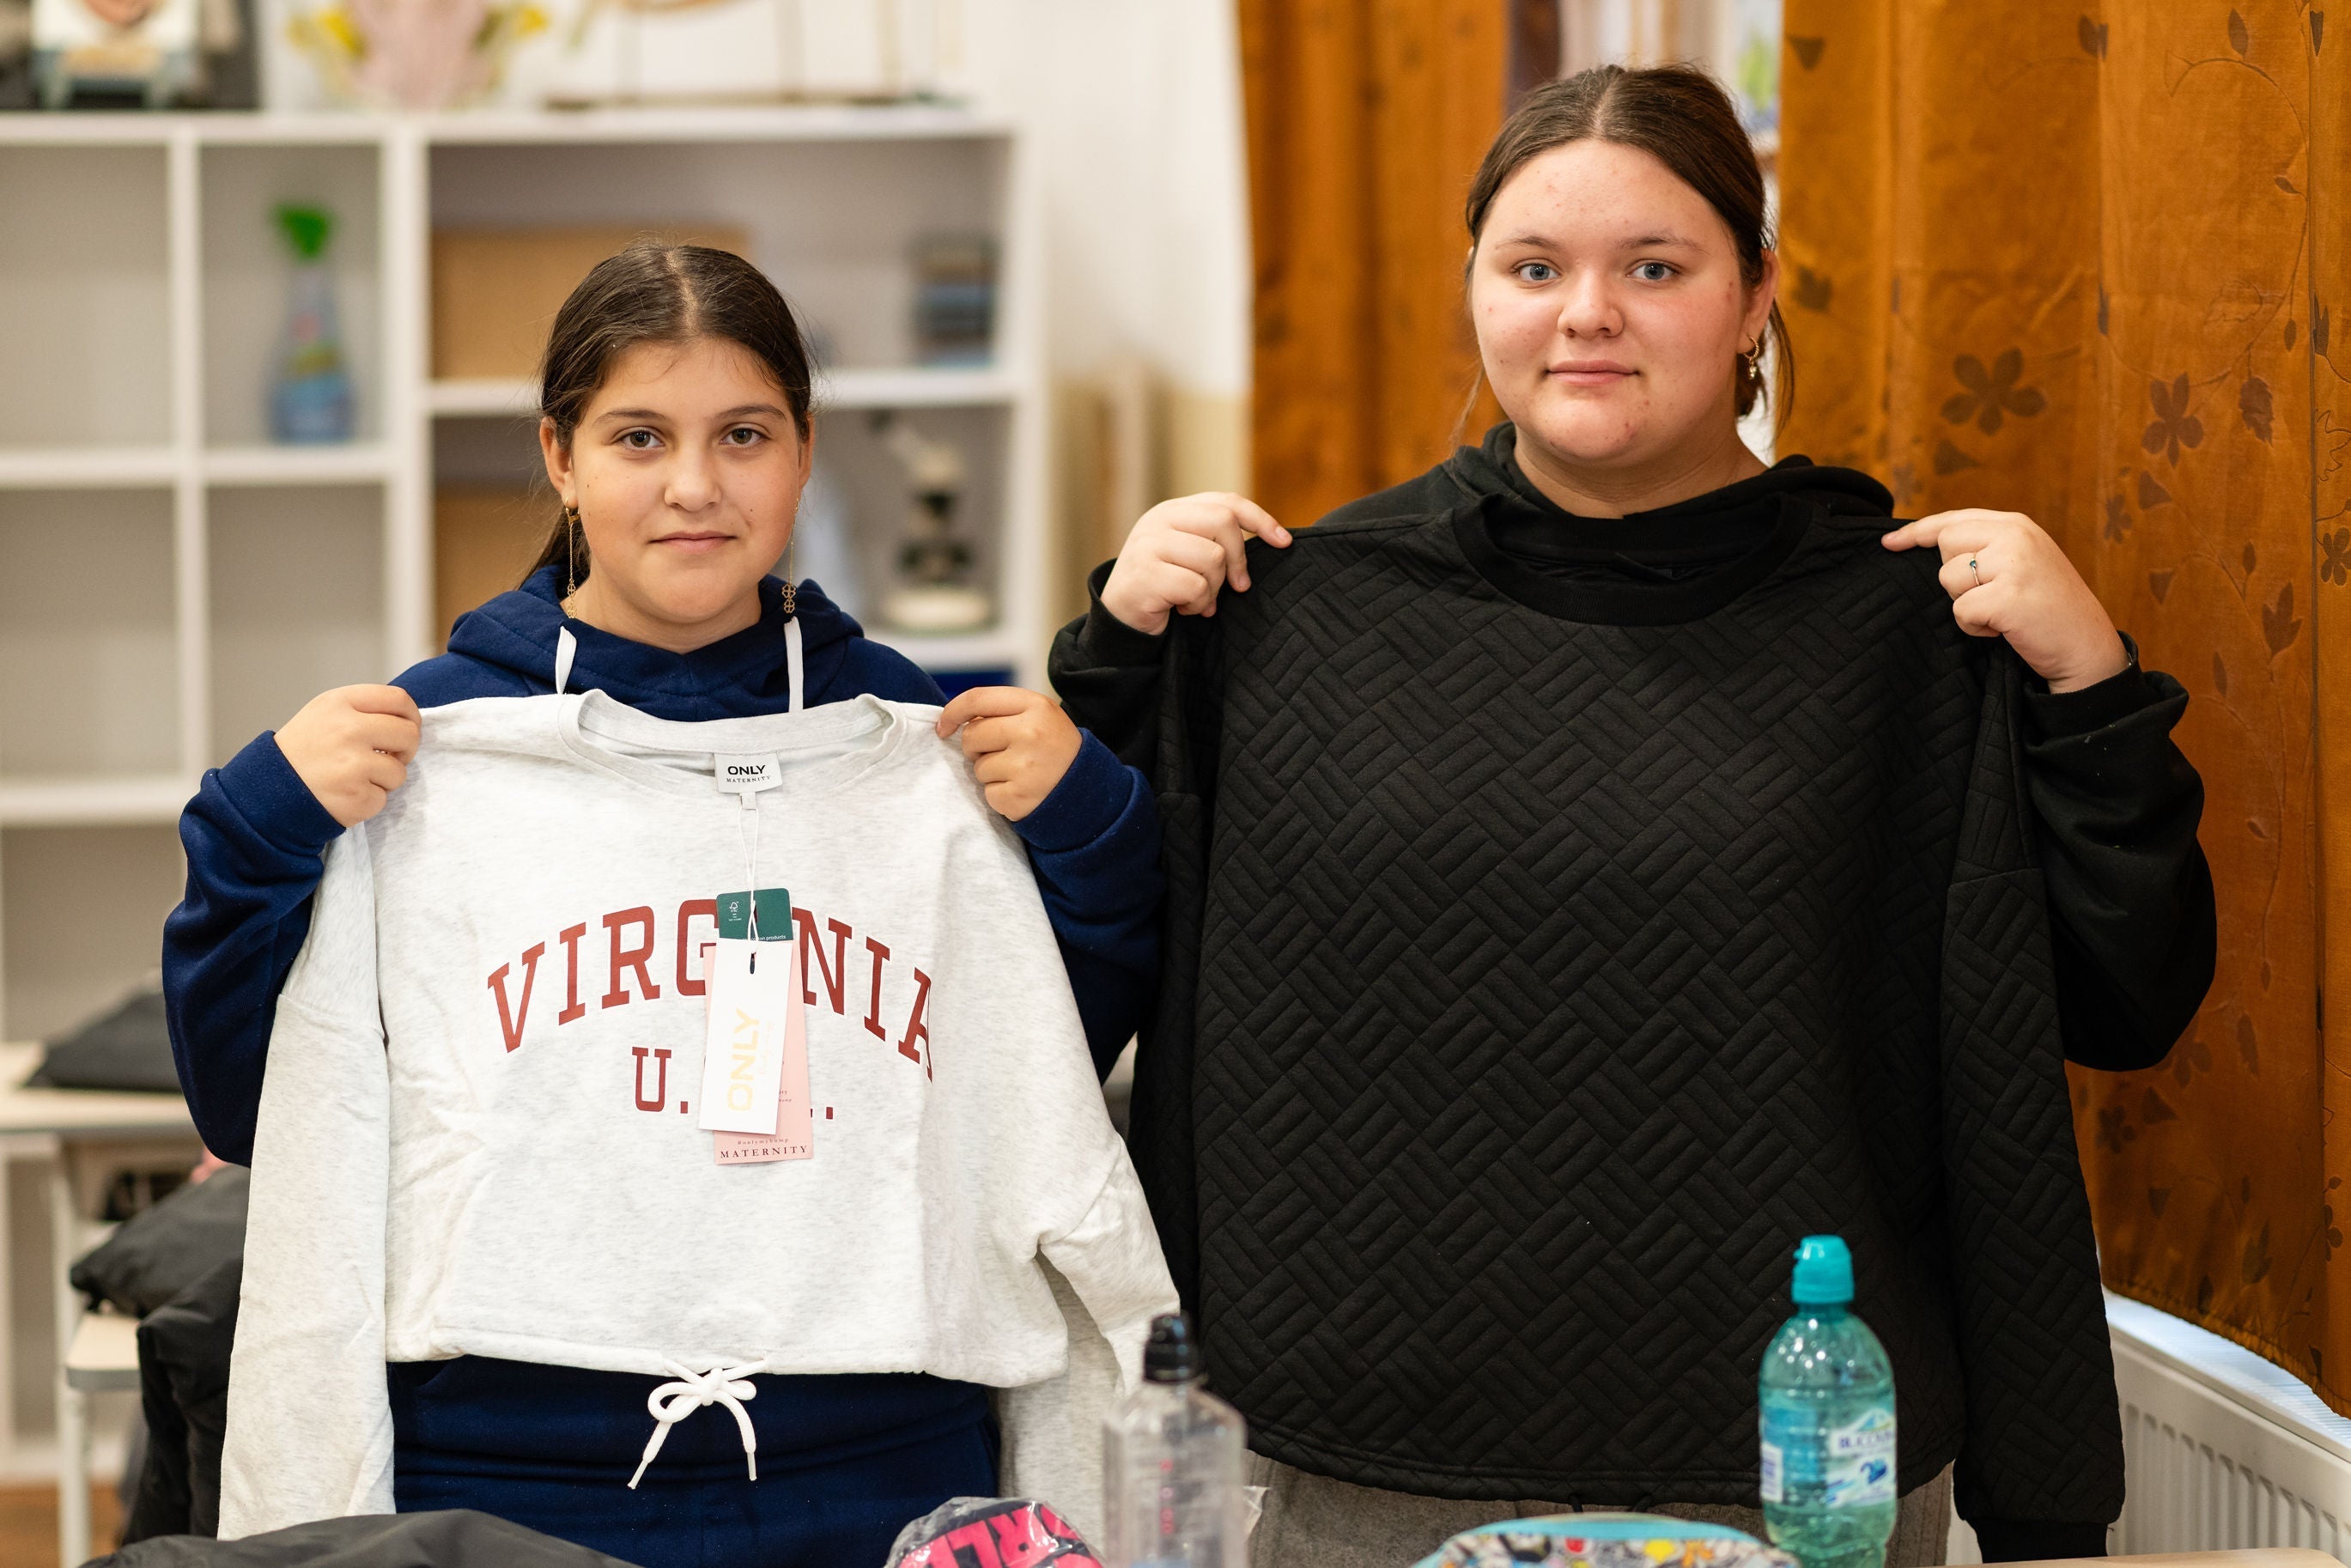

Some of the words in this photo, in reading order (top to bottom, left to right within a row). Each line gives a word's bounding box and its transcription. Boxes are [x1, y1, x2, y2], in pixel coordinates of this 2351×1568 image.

[727, 765, 766, 775] ONLY
[488, 899, 933, 1084] VIRGNIA
[727, 1006, 760, 1111] ONLY
[720, 1146, 807, 1158] MATERNITY
